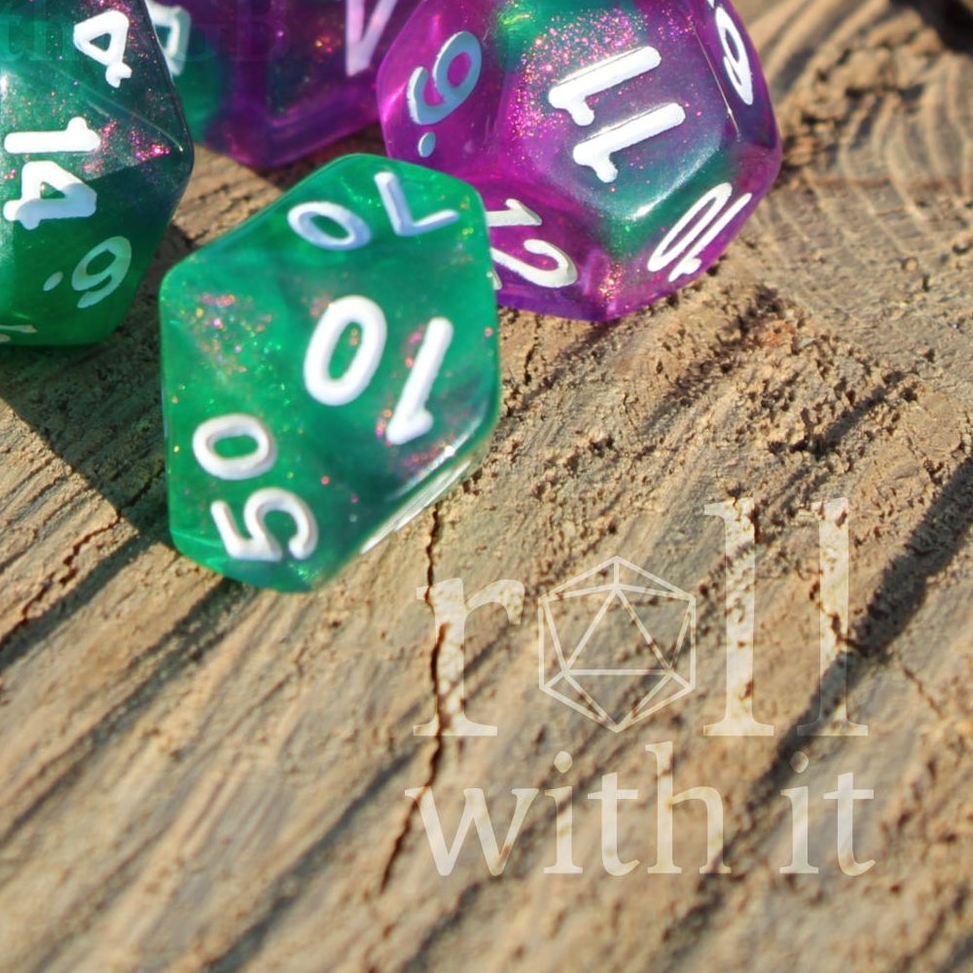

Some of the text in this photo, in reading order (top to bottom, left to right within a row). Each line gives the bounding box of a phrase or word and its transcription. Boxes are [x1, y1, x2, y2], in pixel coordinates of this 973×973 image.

[74, 9, 132, 88] 4
[547, 45, 686, 184] 11
[3, 116, 101, 230] 14
[287, 171, 461, 251] 70
[646, 182, 752, 282] 10
[303, 295, 454, 446] 10
[192, 413, 319, 562] 50
